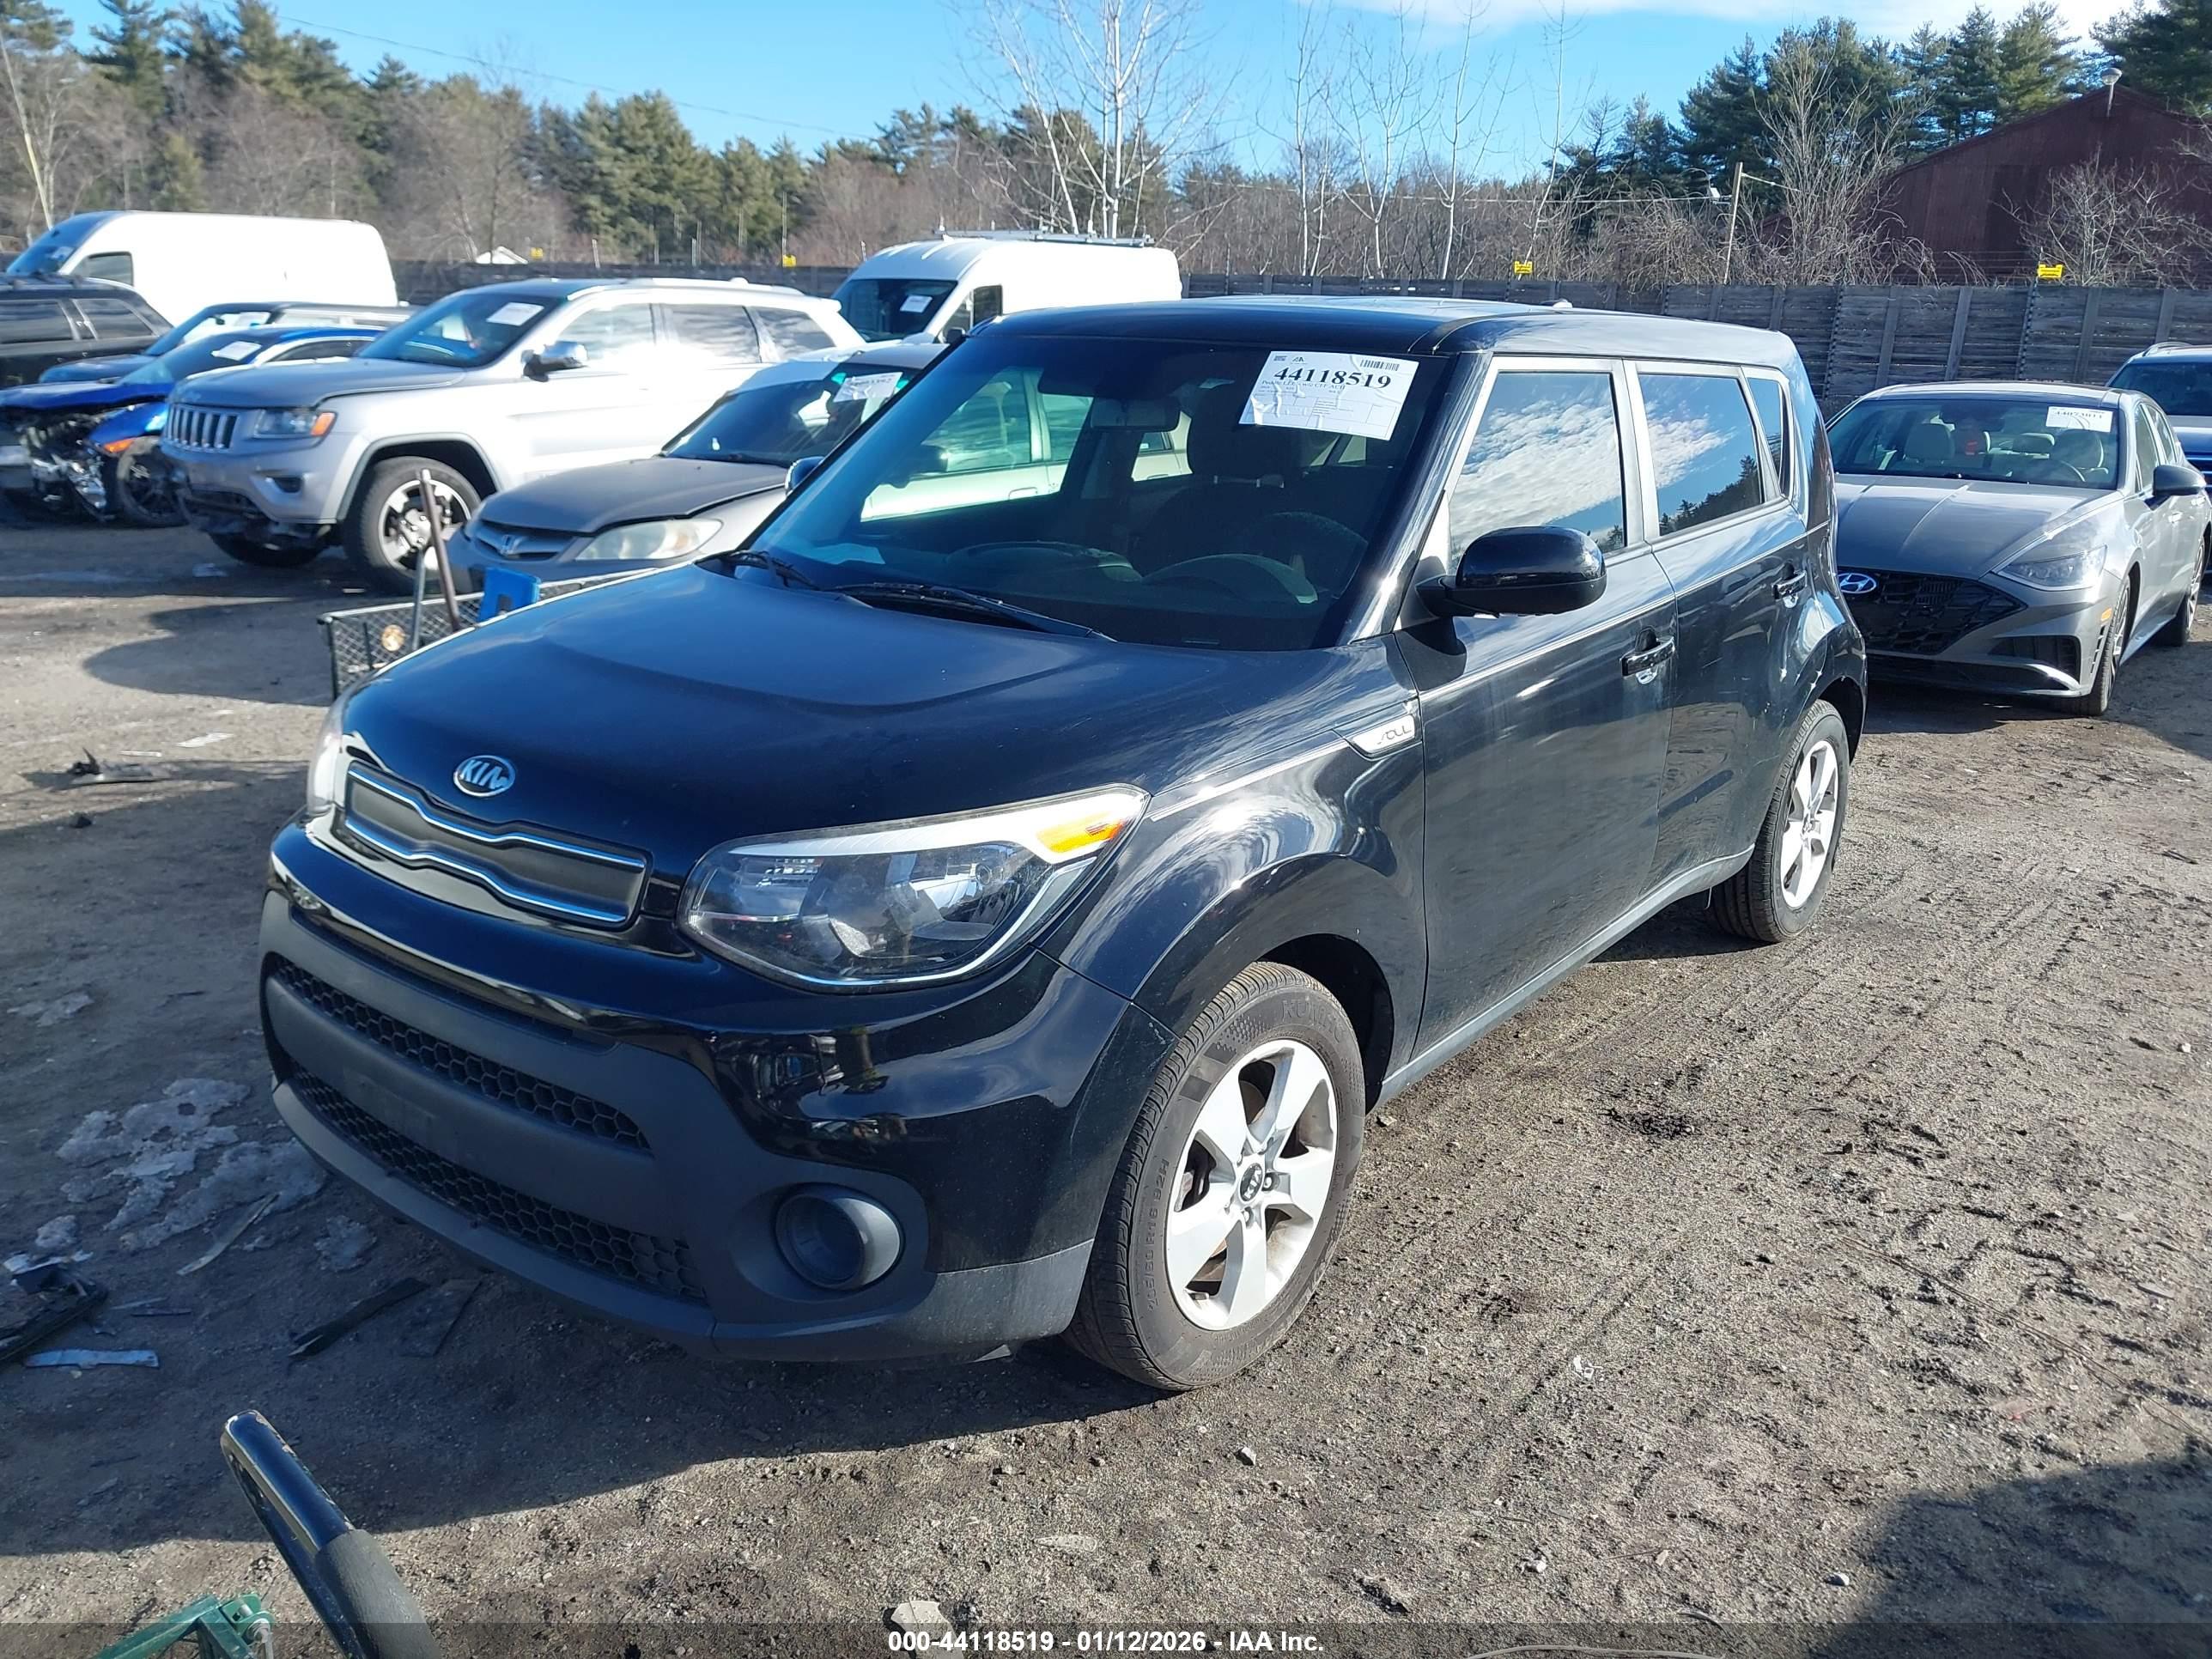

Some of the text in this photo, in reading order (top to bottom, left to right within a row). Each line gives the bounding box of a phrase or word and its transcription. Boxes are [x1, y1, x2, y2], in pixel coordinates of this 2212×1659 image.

[1273, 367, 1391, 389] 44118519
[459, 759, 508, 790] KIA
[1243, 1170, 1262, 1200] KIA
